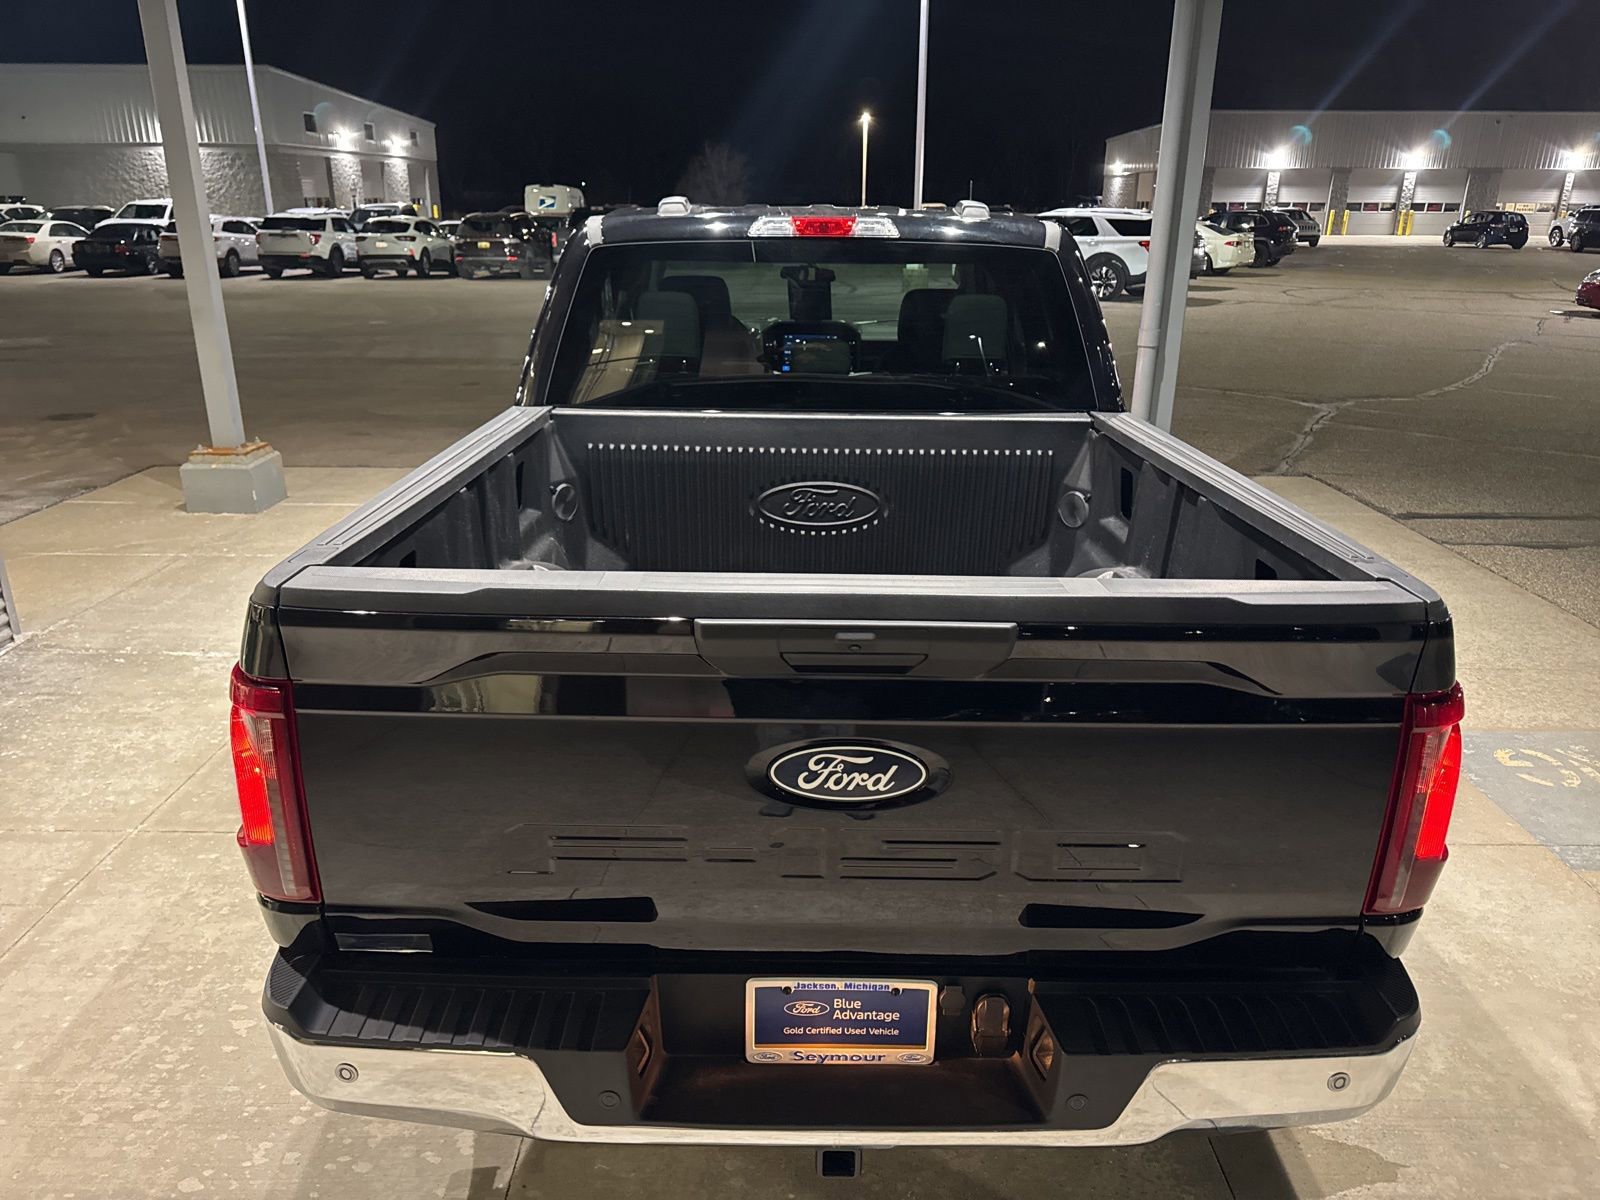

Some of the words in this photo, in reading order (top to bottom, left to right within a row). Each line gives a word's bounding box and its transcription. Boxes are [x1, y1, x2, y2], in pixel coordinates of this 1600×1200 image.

[783, 487, 856, 517] Ford
[797, 753, 899, 792] Ford
[794, 982, 840, 990] Jackson,
[844, 983, 890, 991] Michigan
[792, 1003, 821, 1014] Ford
[833, 998, 862, 1009] Blue
[832, 1009, 900, 1022] Advantage
[783, 1026, 804, 1035] Gold
[805, 1026, 842, 1035] Certified
[844, 1027, 866, 1035] Used
[868, 1027, 900, 1036] Vehicle
[793, 1051, 886, 1063] Seymour
